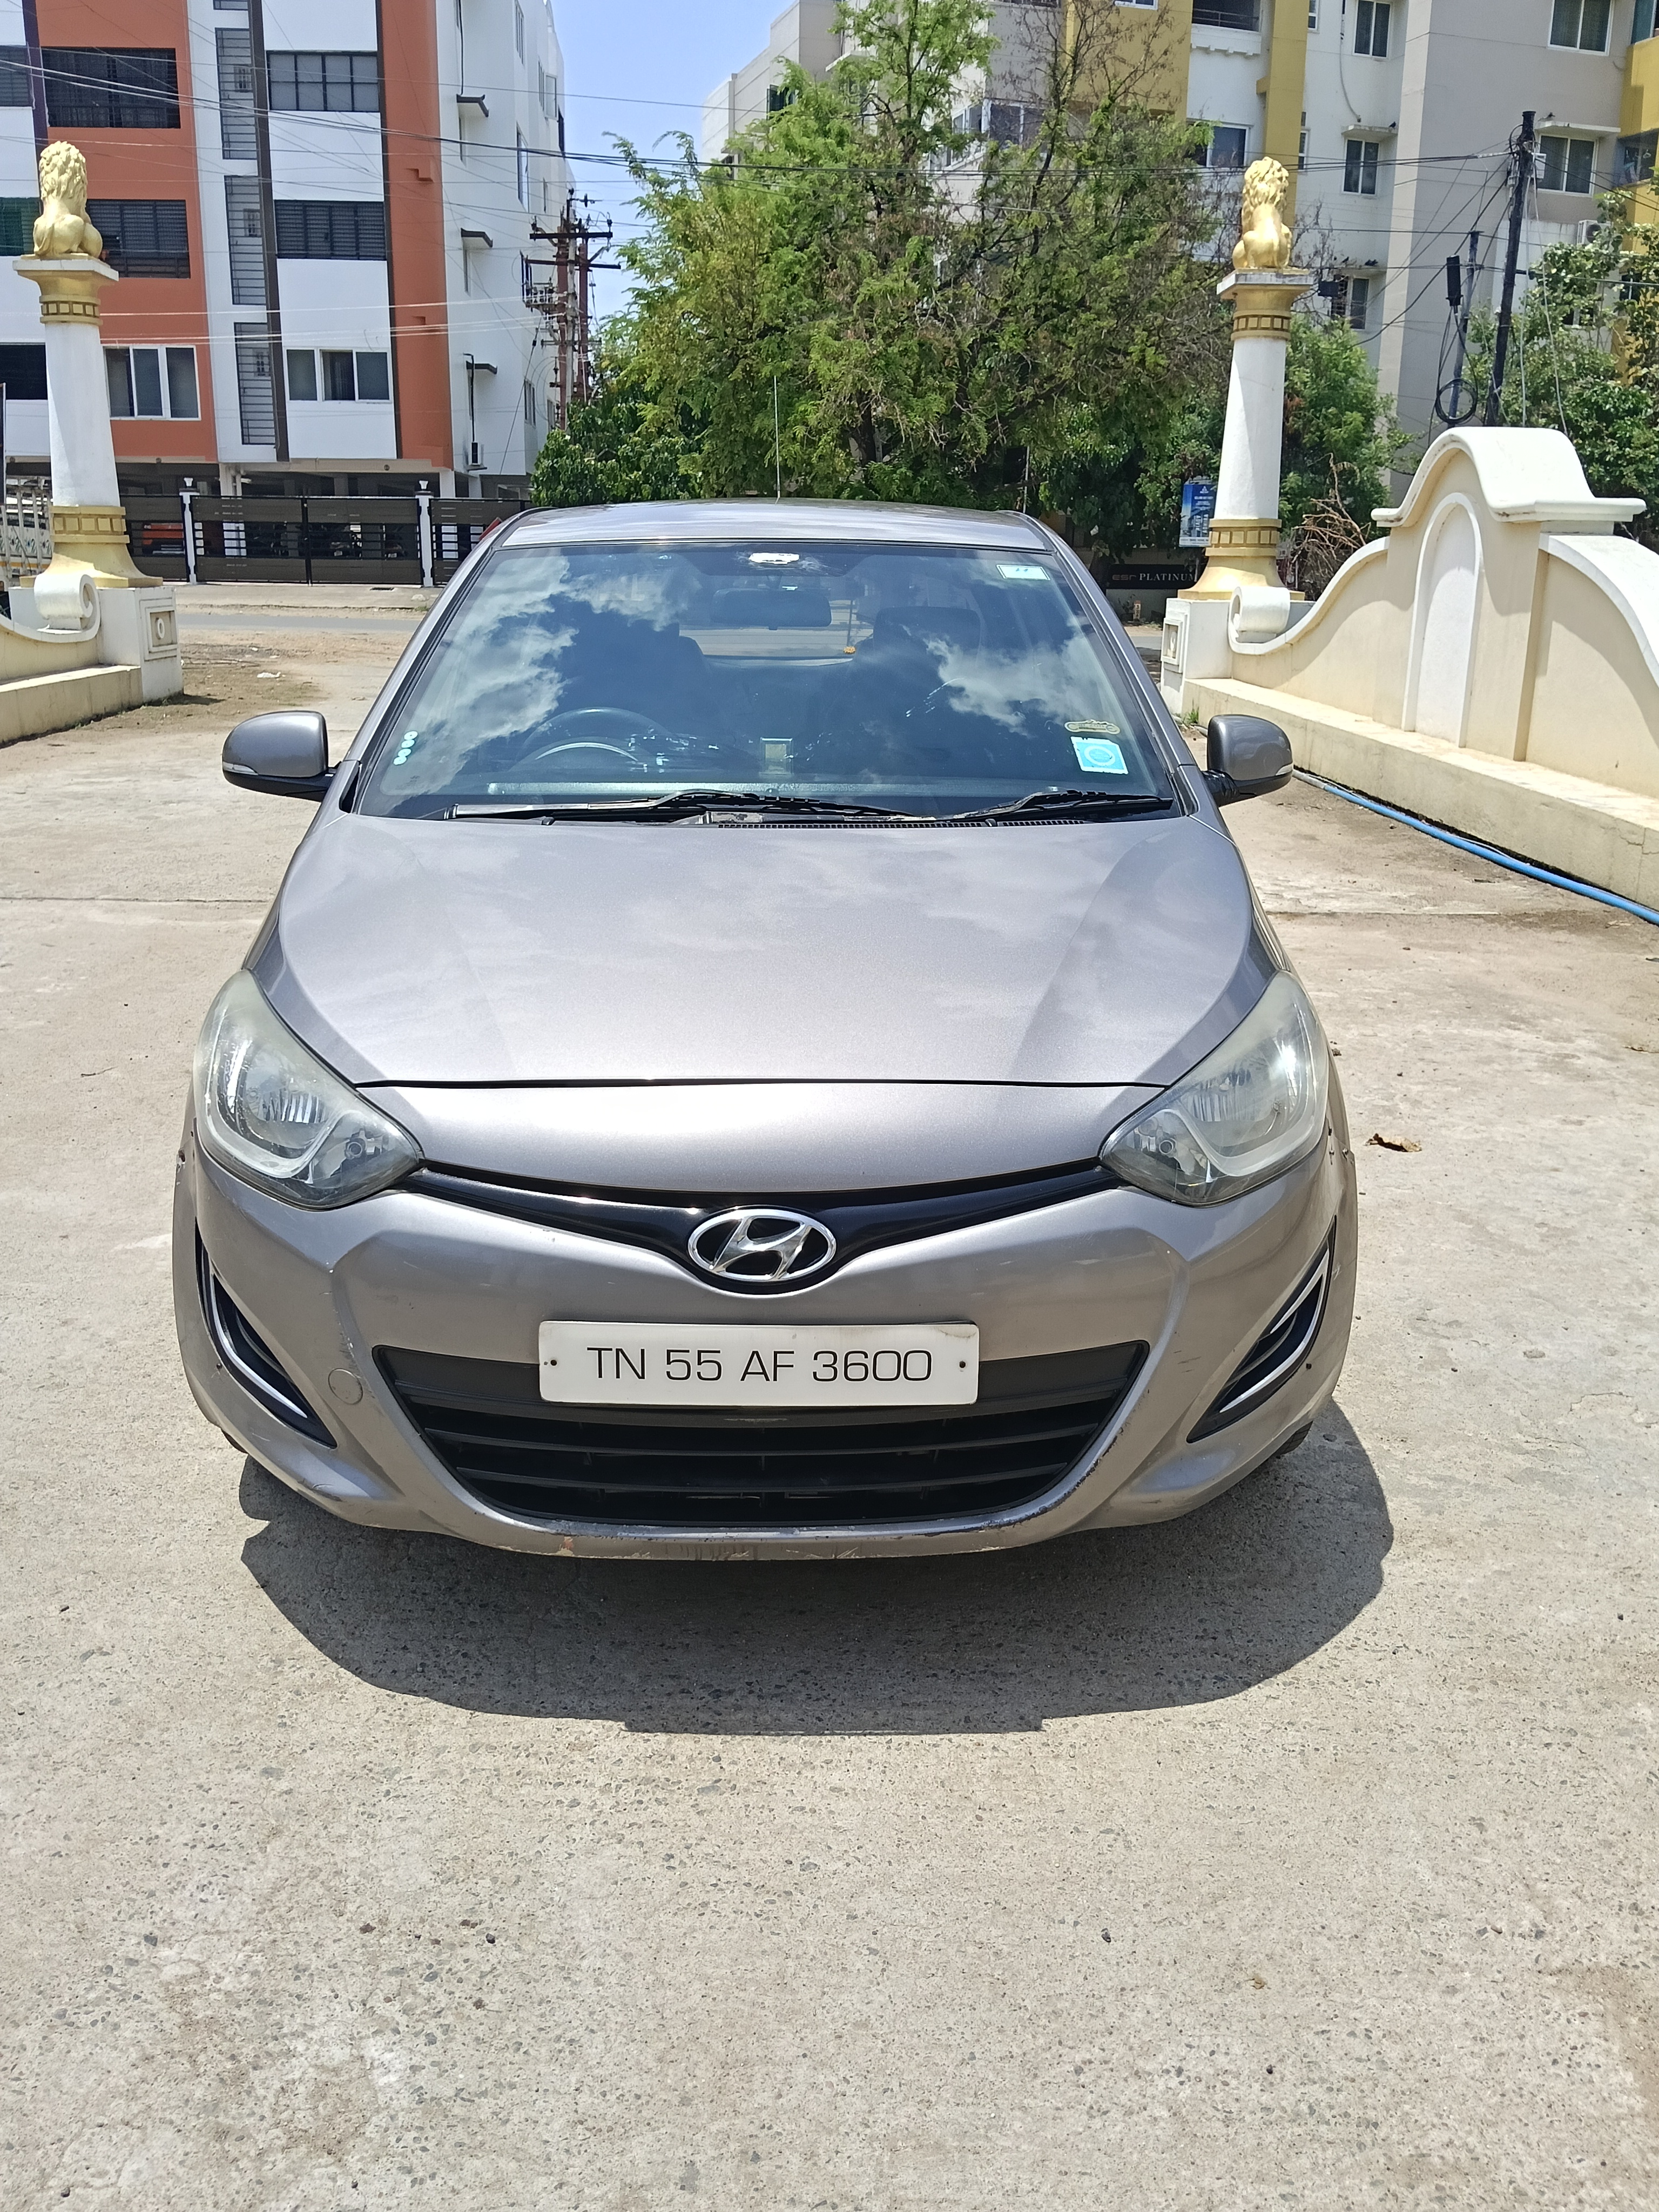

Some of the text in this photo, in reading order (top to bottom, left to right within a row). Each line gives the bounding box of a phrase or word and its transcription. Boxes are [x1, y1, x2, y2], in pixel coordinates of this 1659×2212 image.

[586, 1347, 932, 1382] TN 55 AF 3600
